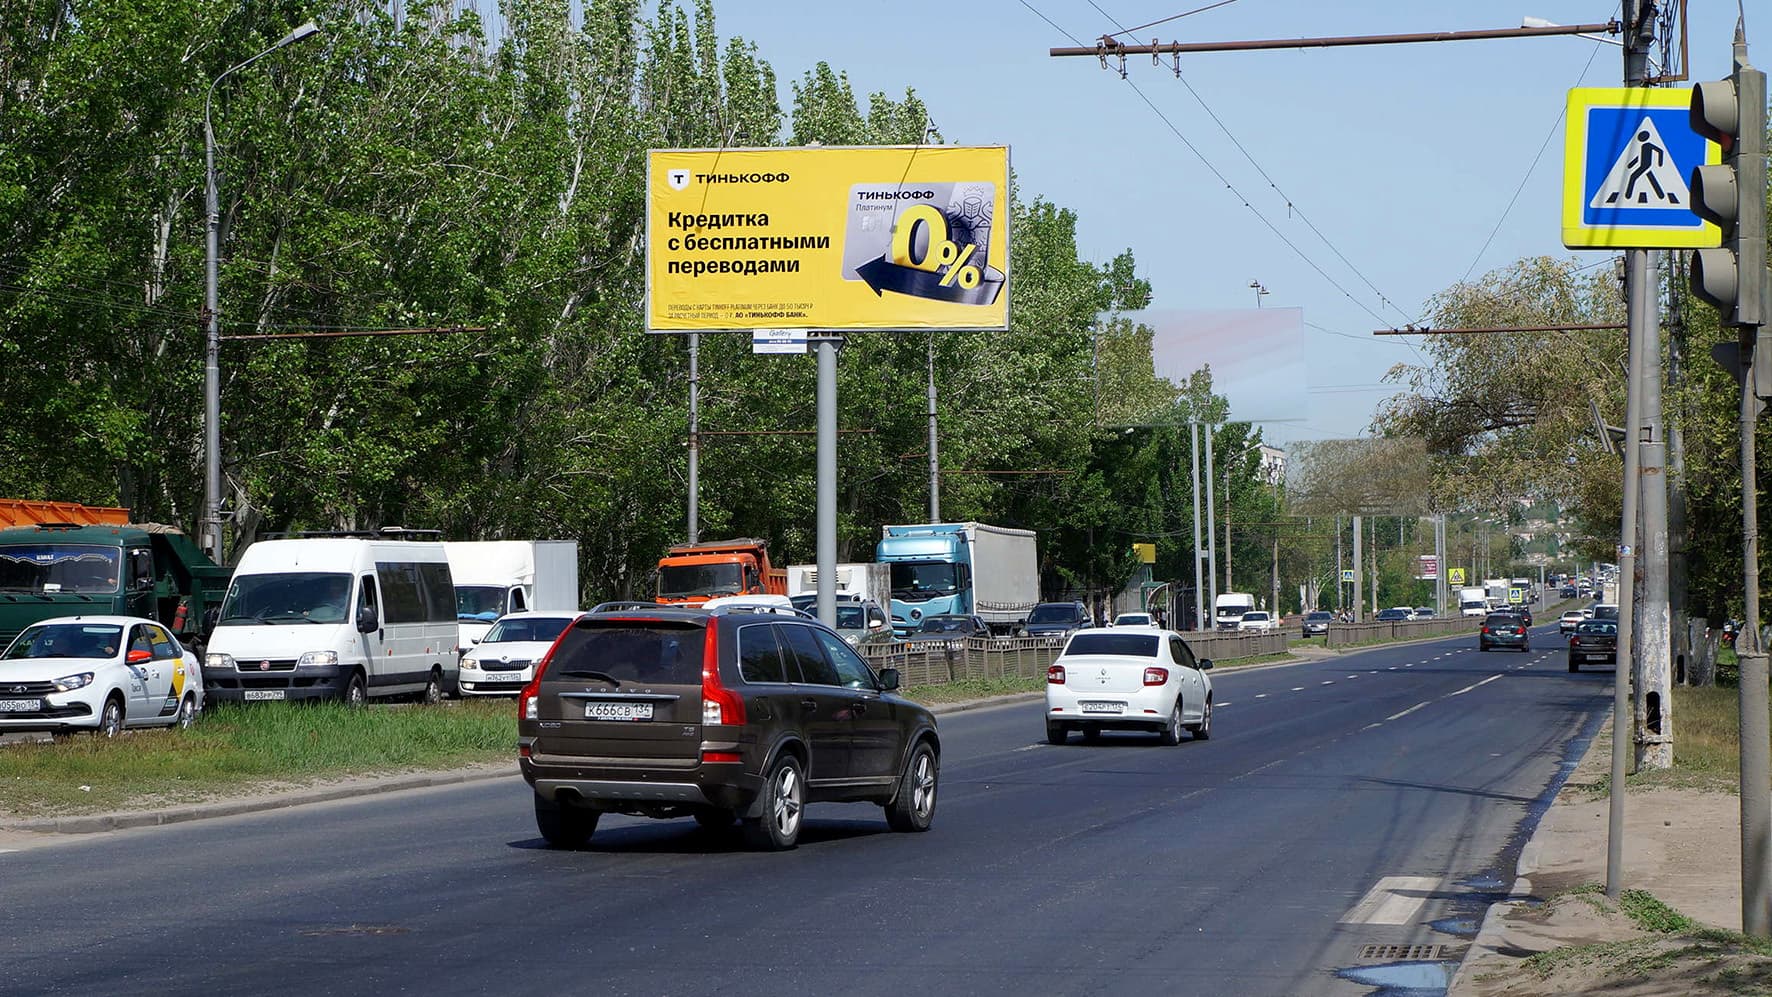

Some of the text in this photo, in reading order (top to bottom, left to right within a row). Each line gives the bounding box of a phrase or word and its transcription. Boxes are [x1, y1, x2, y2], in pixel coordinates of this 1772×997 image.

[695, 173, 790, 184] ТИНЬКОФФ
[857, 190, 935, 200] ТИНЬКОФФ
[856, 204, 893, 213] Платинум
[668, 211, 769, 231] Кредитка
[668, 233, 830, 250] с бесплатными
[891, 203, 981, 290] 0%
[668, 259, 800, 278] переводами
[589, 703, 650, 716] К666СВ 134
